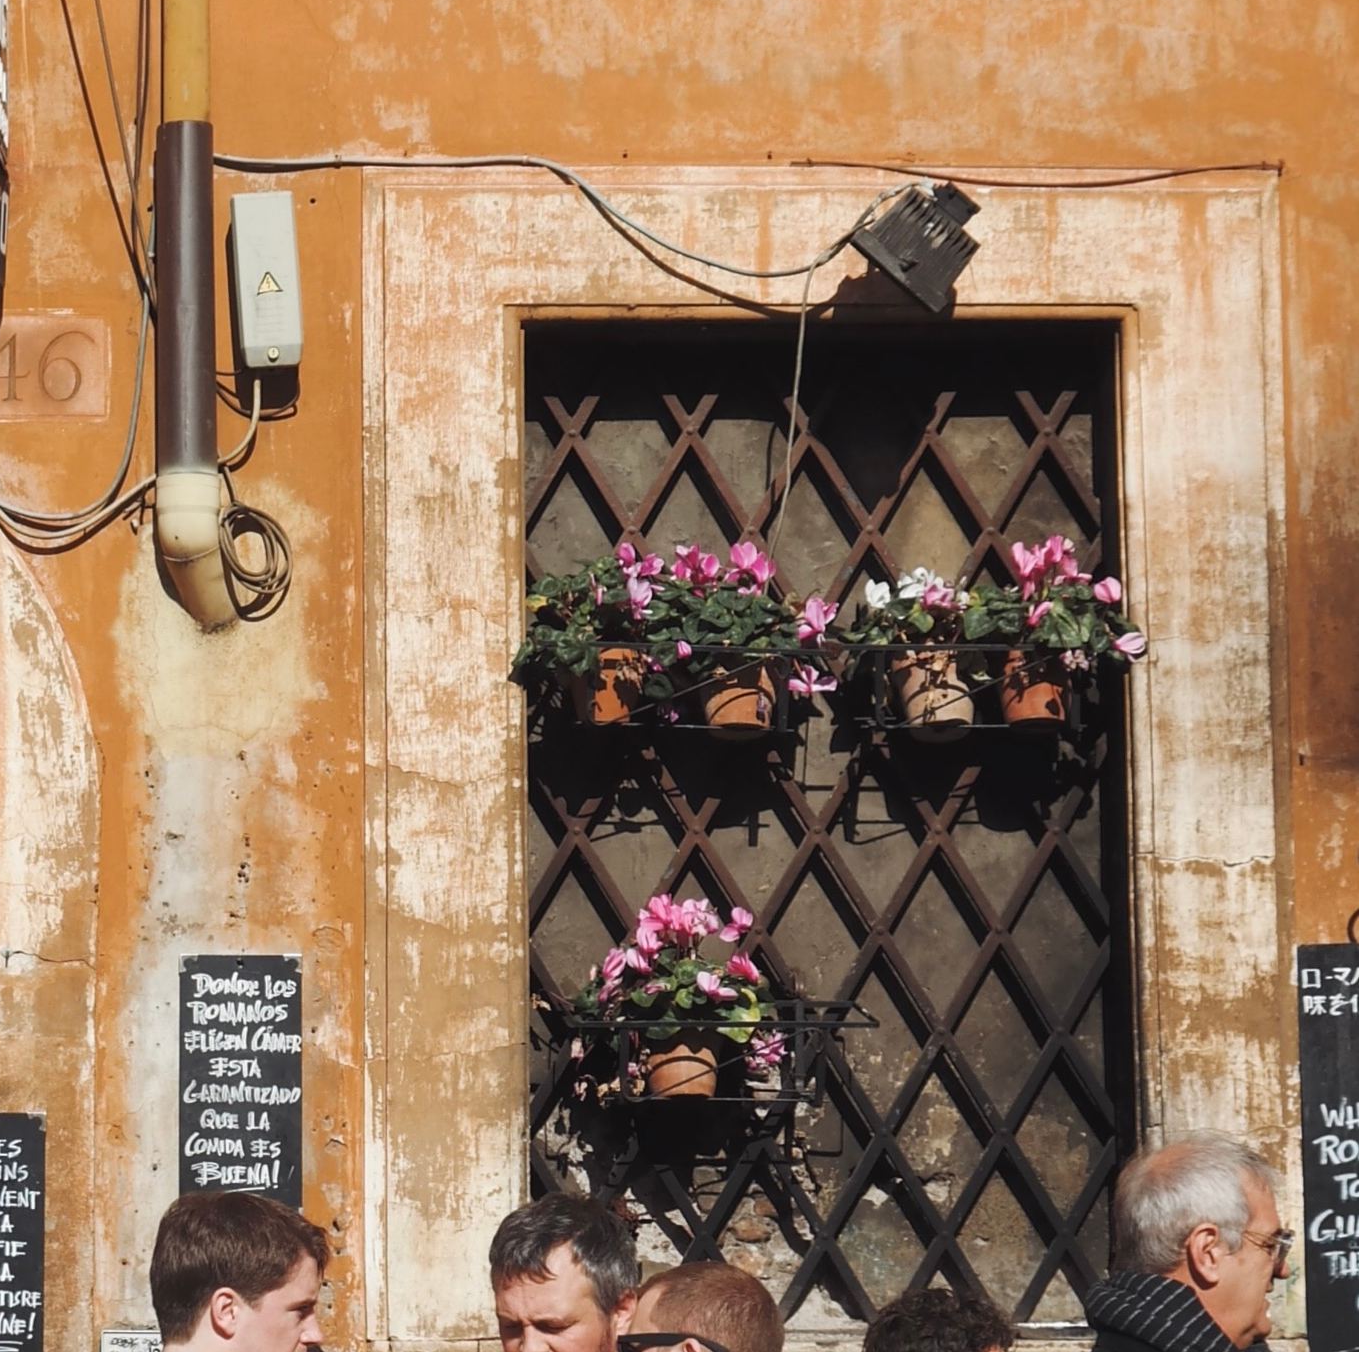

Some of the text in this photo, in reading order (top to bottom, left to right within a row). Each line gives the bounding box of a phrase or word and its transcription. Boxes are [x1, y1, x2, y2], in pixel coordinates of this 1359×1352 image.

[191, 972, 297, 999] DONDE LOS
[186, 1000, 288, 1026] ROMANOS
[183, 1079, 301, 1105] GARANTIZADO
[200, 1108, 270, 1131] QUE LA
[184, 1132, 281, 1158] COMIDA ES
[1312, 1135, 1359, 1165] RO
[191, 1160, 280, 1189] BUENA!
[1309, 1209, 1359, 1242] GU
